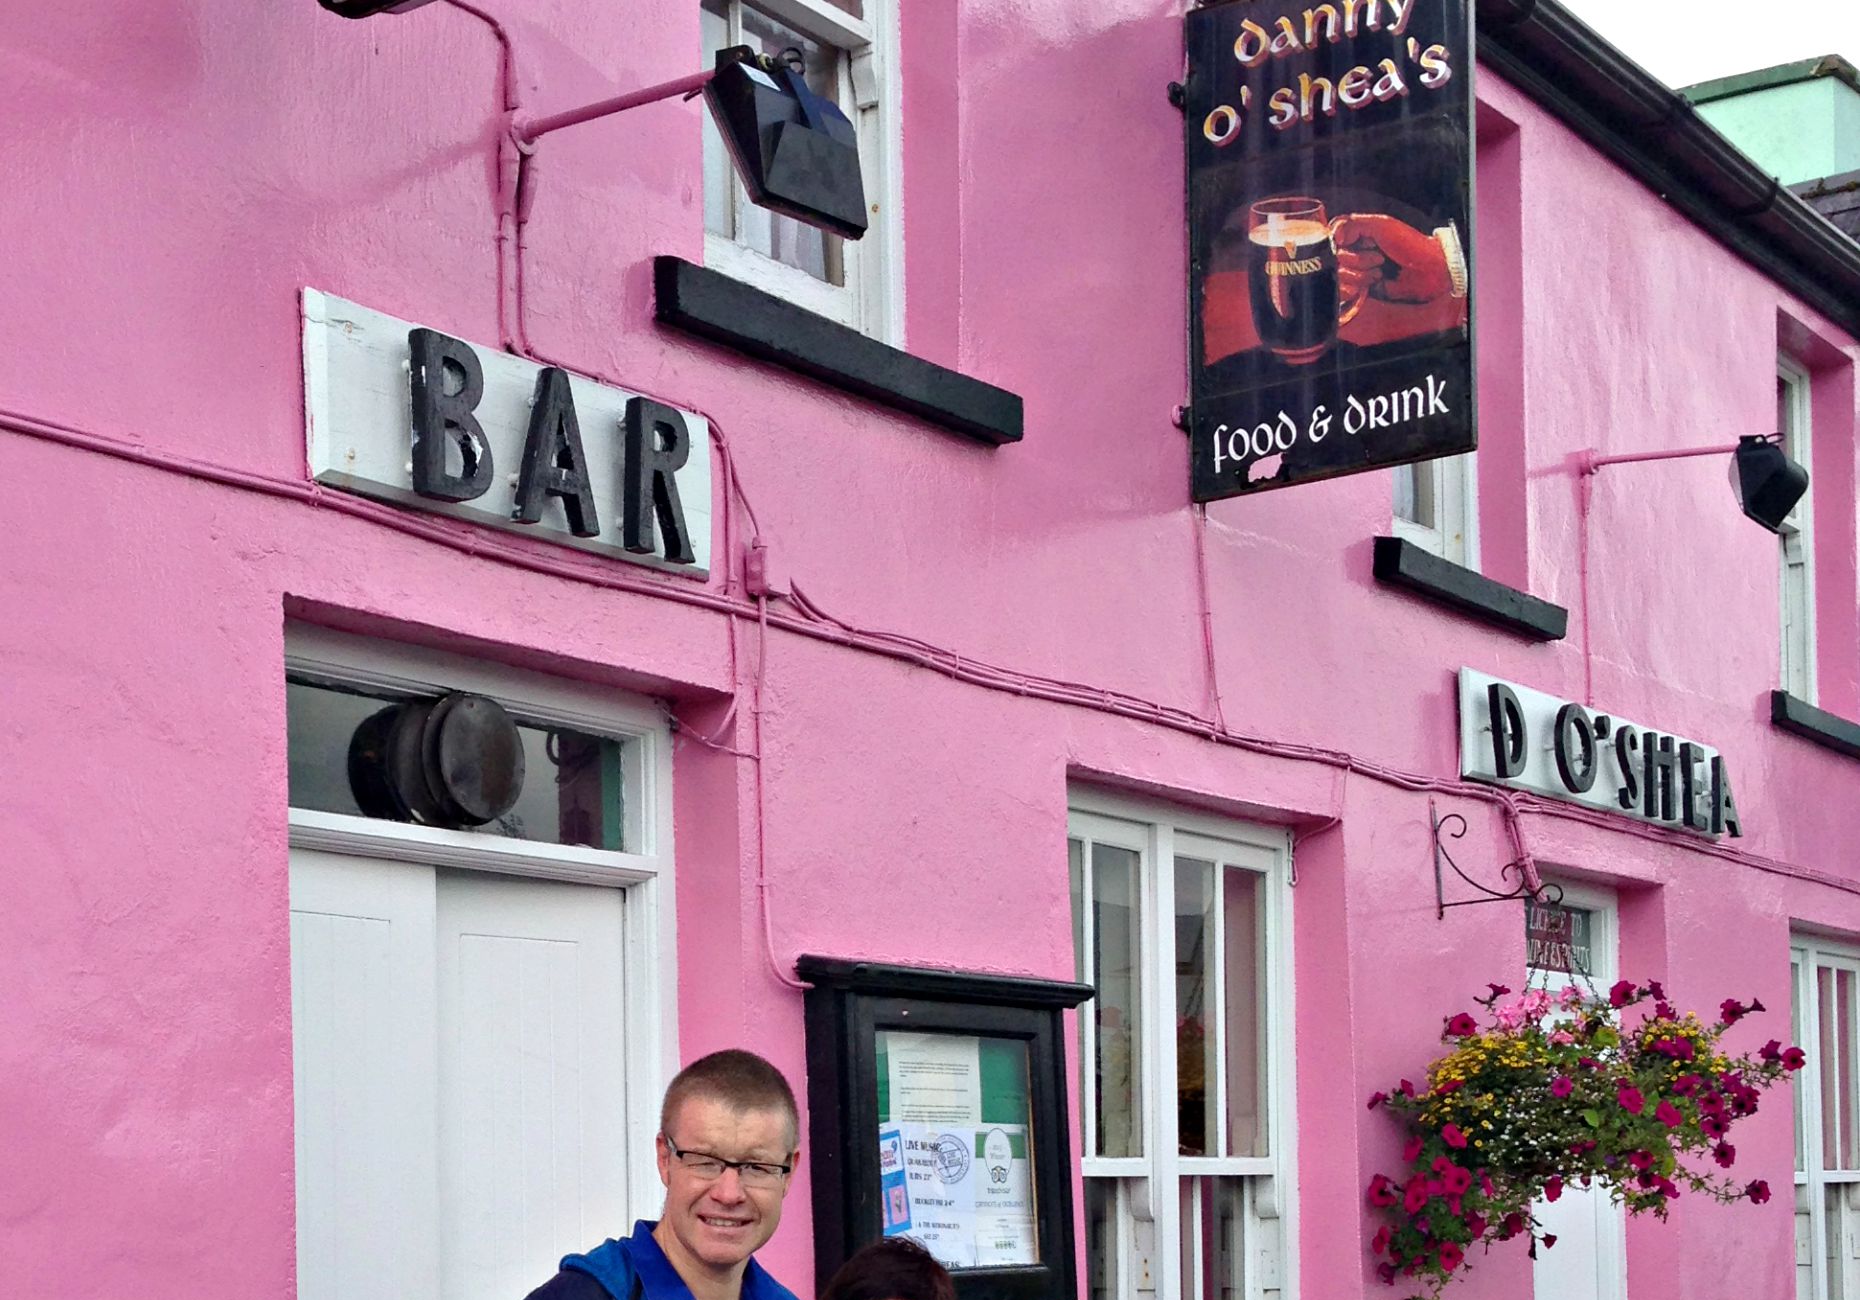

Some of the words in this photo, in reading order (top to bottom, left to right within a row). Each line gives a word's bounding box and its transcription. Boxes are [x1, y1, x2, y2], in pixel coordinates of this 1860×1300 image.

[1234, 0, 1413, 68] danny
[408, 327, 697, 565] BAR
[1213, 410, 1297, 474] food
[1308, 404, 1333, 443] &
[1487, 683, 1528, 779] D
[1554, 702, 1743, 838] O'SHEA
[1571, 912, 1583, 937] TO
